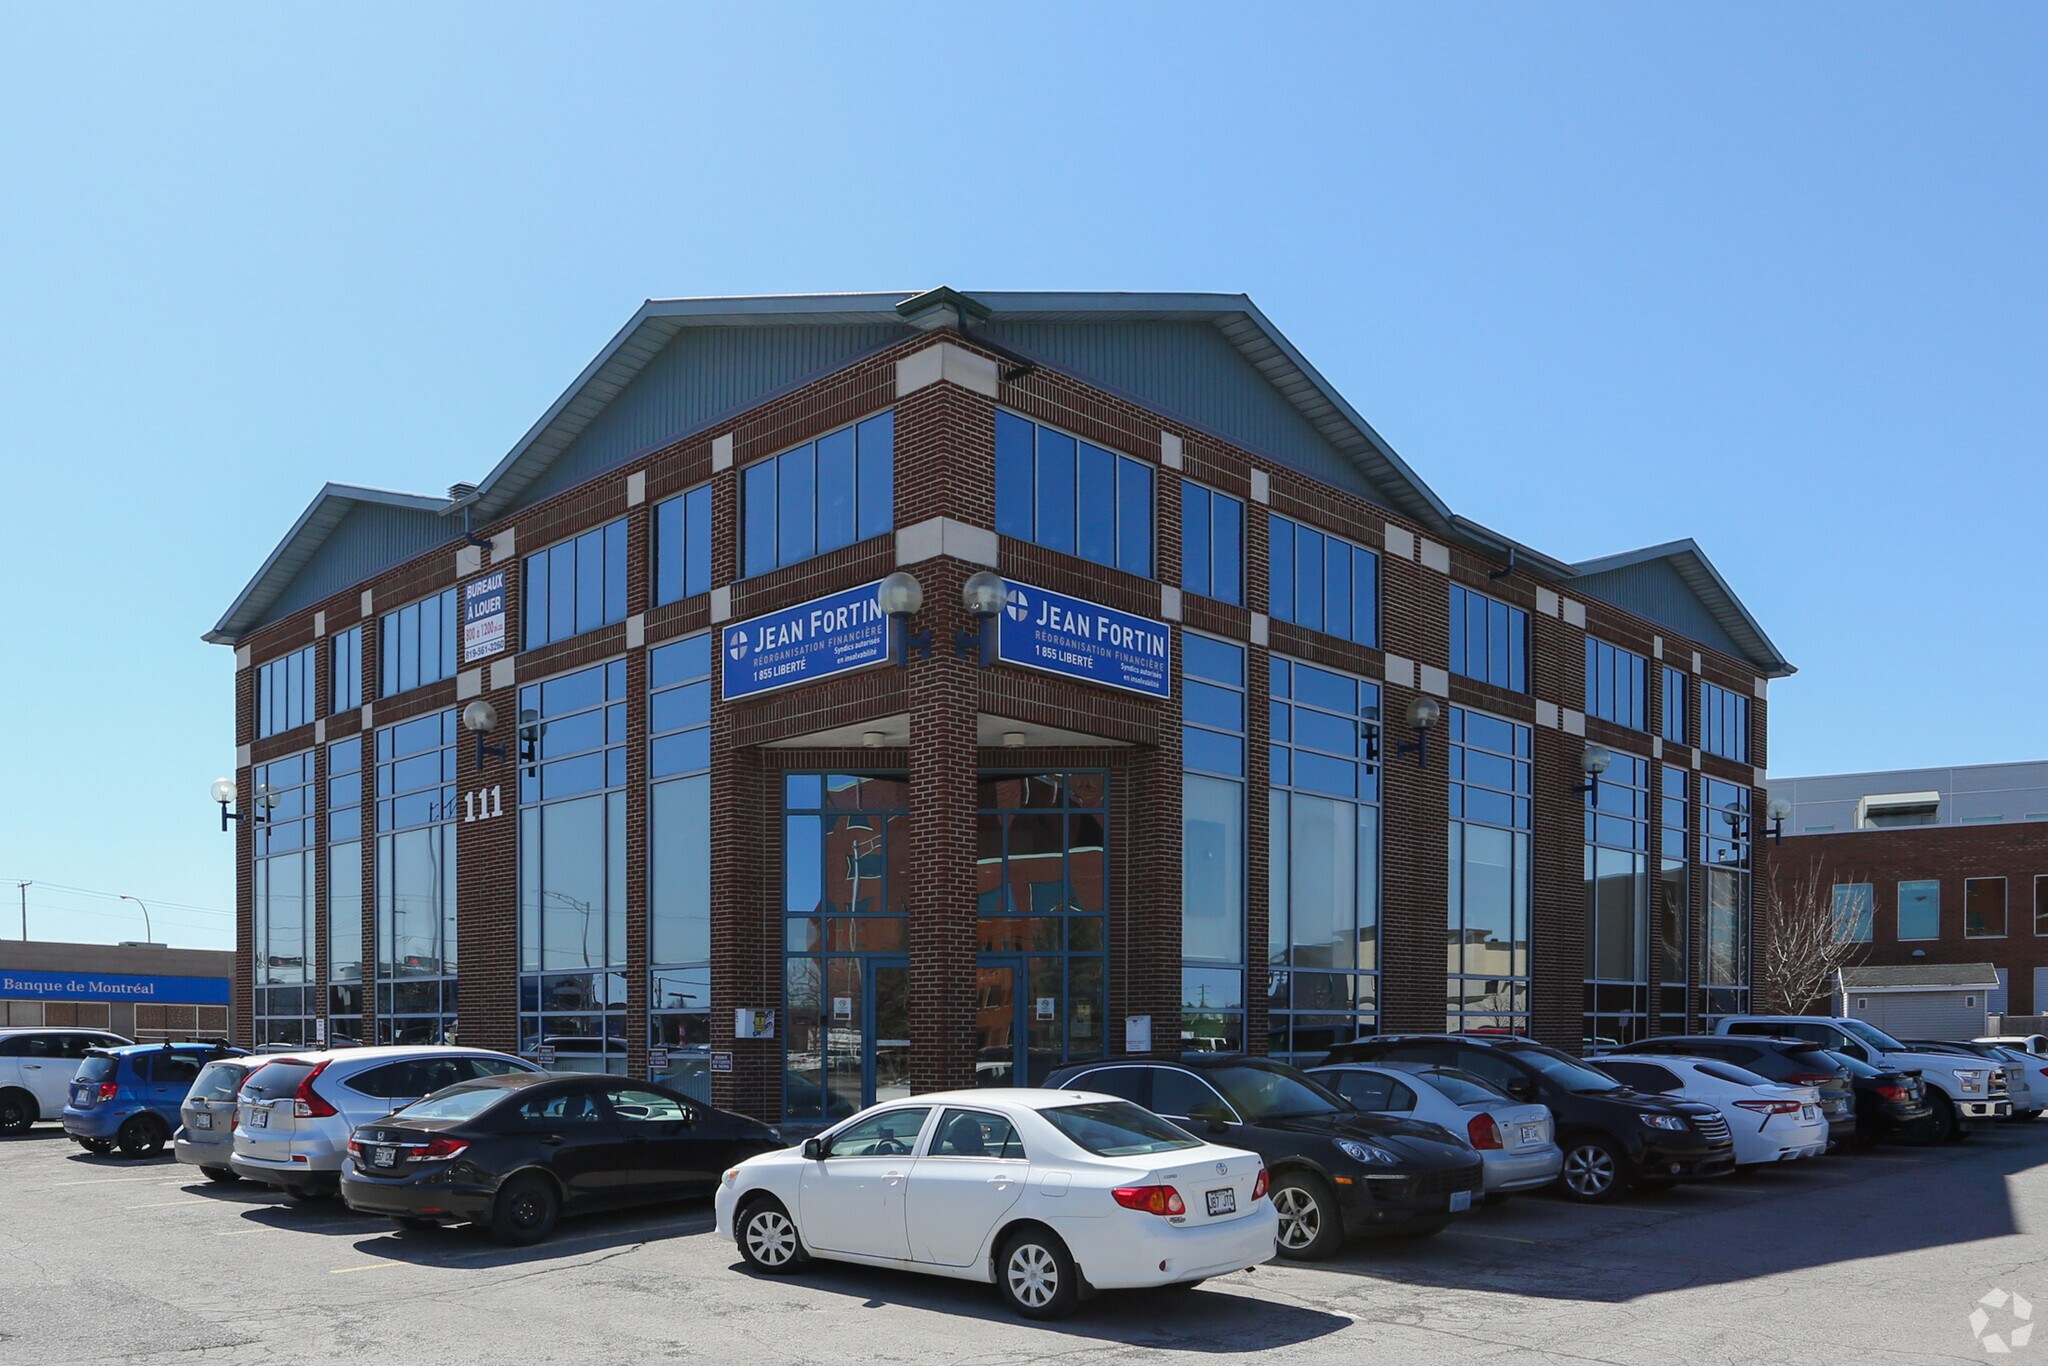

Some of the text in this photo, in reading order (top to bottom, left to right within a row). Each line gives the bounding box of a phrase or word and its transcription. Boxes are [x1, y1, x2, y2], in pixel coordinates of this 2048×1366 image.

[467, 573, 503, 600] BUREAUX
[467, 596, 501, 620] À LOUER
[481, 620, 494, 637] 1200
[754, 598, 882, 653] JEAN FORTIN
[1036, 600, 1165, 658] JEAN FORTIN
[753, 624, 882, 667] RÉORGANISATION FINANCIÈRE
[834, 636, 880, 655] Syndics autorisés
[1035, 630, 1164, 672] RÉORGANISATION FINANCIÈRE
[1035, 645, 1093, 669] 1 855 LIBERTÉ
[753, 656, 806, 682] 1 855 LIBERTÉ
[1120, 662, 1162, 679] Syndics autorisés
[464, 785, 503, 823] 111
[3, 978, 155, 995] Banque de Montréal
